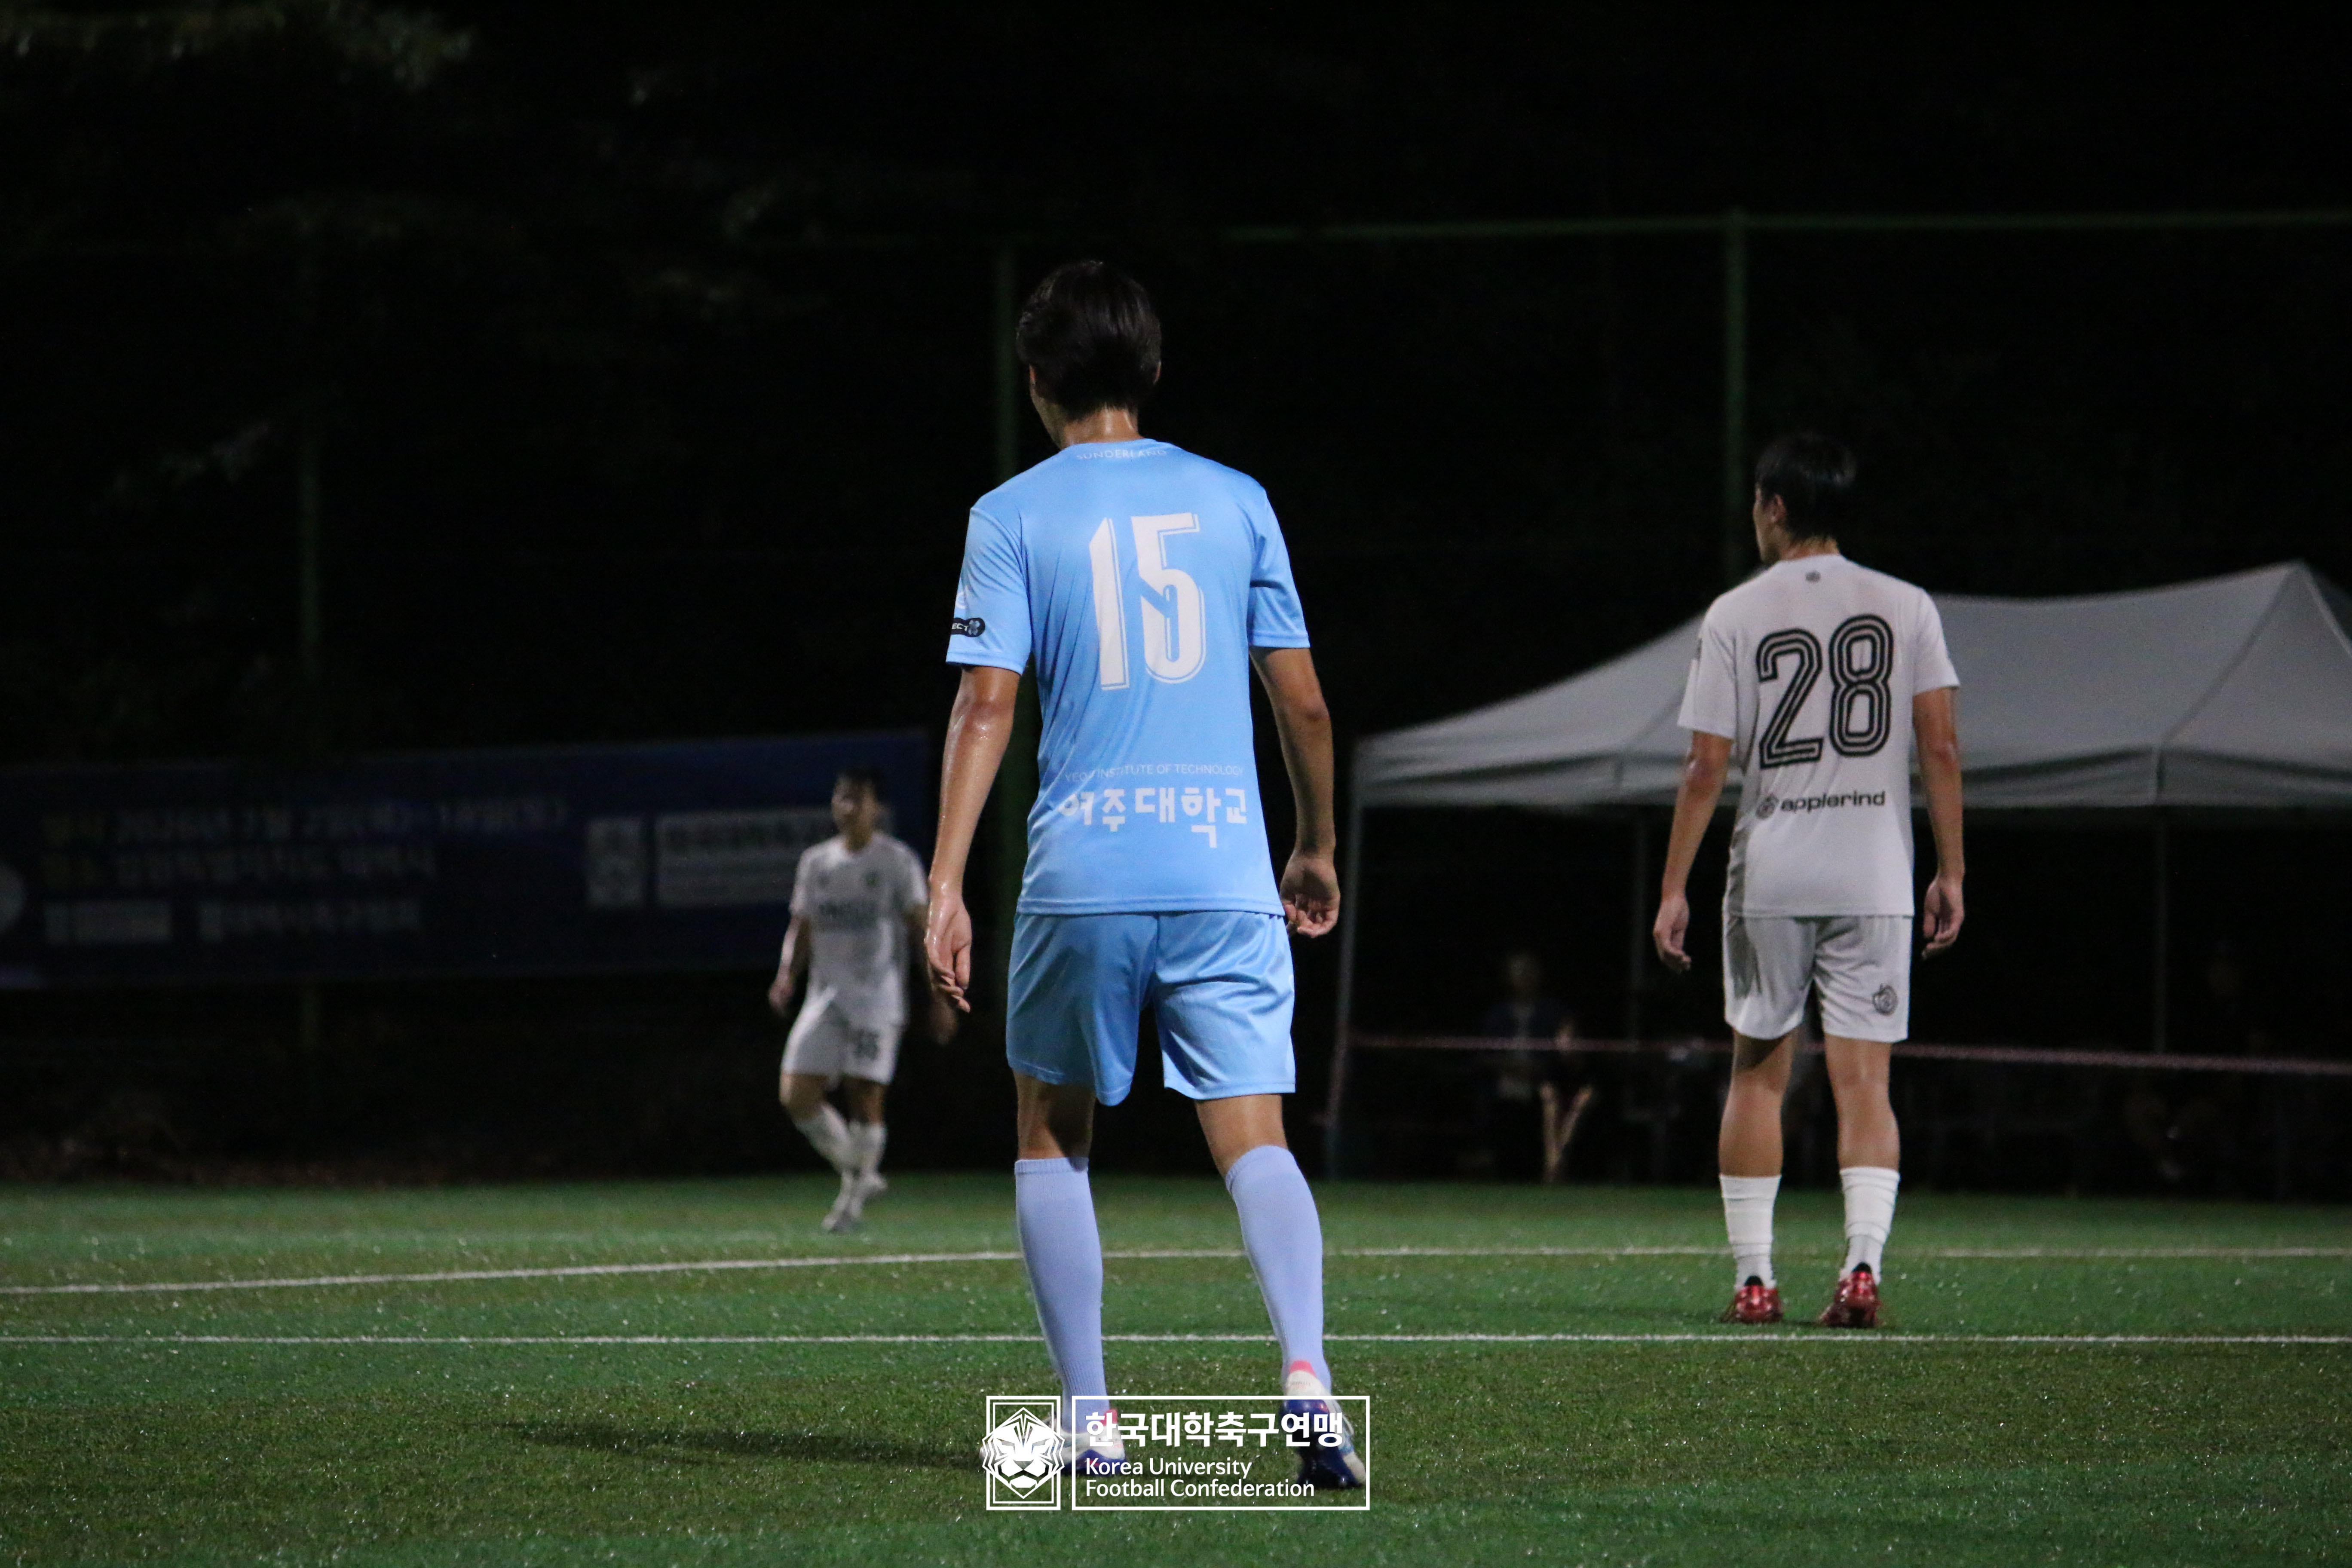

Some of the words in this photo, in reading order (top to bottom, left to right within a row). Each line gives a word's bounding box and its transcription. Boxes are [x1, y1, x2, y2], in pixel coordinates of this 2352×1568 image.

[1076, 449, 1167, 460] SUNDERLAND
[1089, 512, 1206, 691] 15
[951, 622, 969, 631] ECT
[1755, 614, 1893, 769] 28
[1156, 764, 1172, 775] OF
[1173, 764, 1243, 776] TECHNOLOGY
[1781, 790, 1886, 814] applerind
[1059, 787, 1247, 848] 여주대학교
